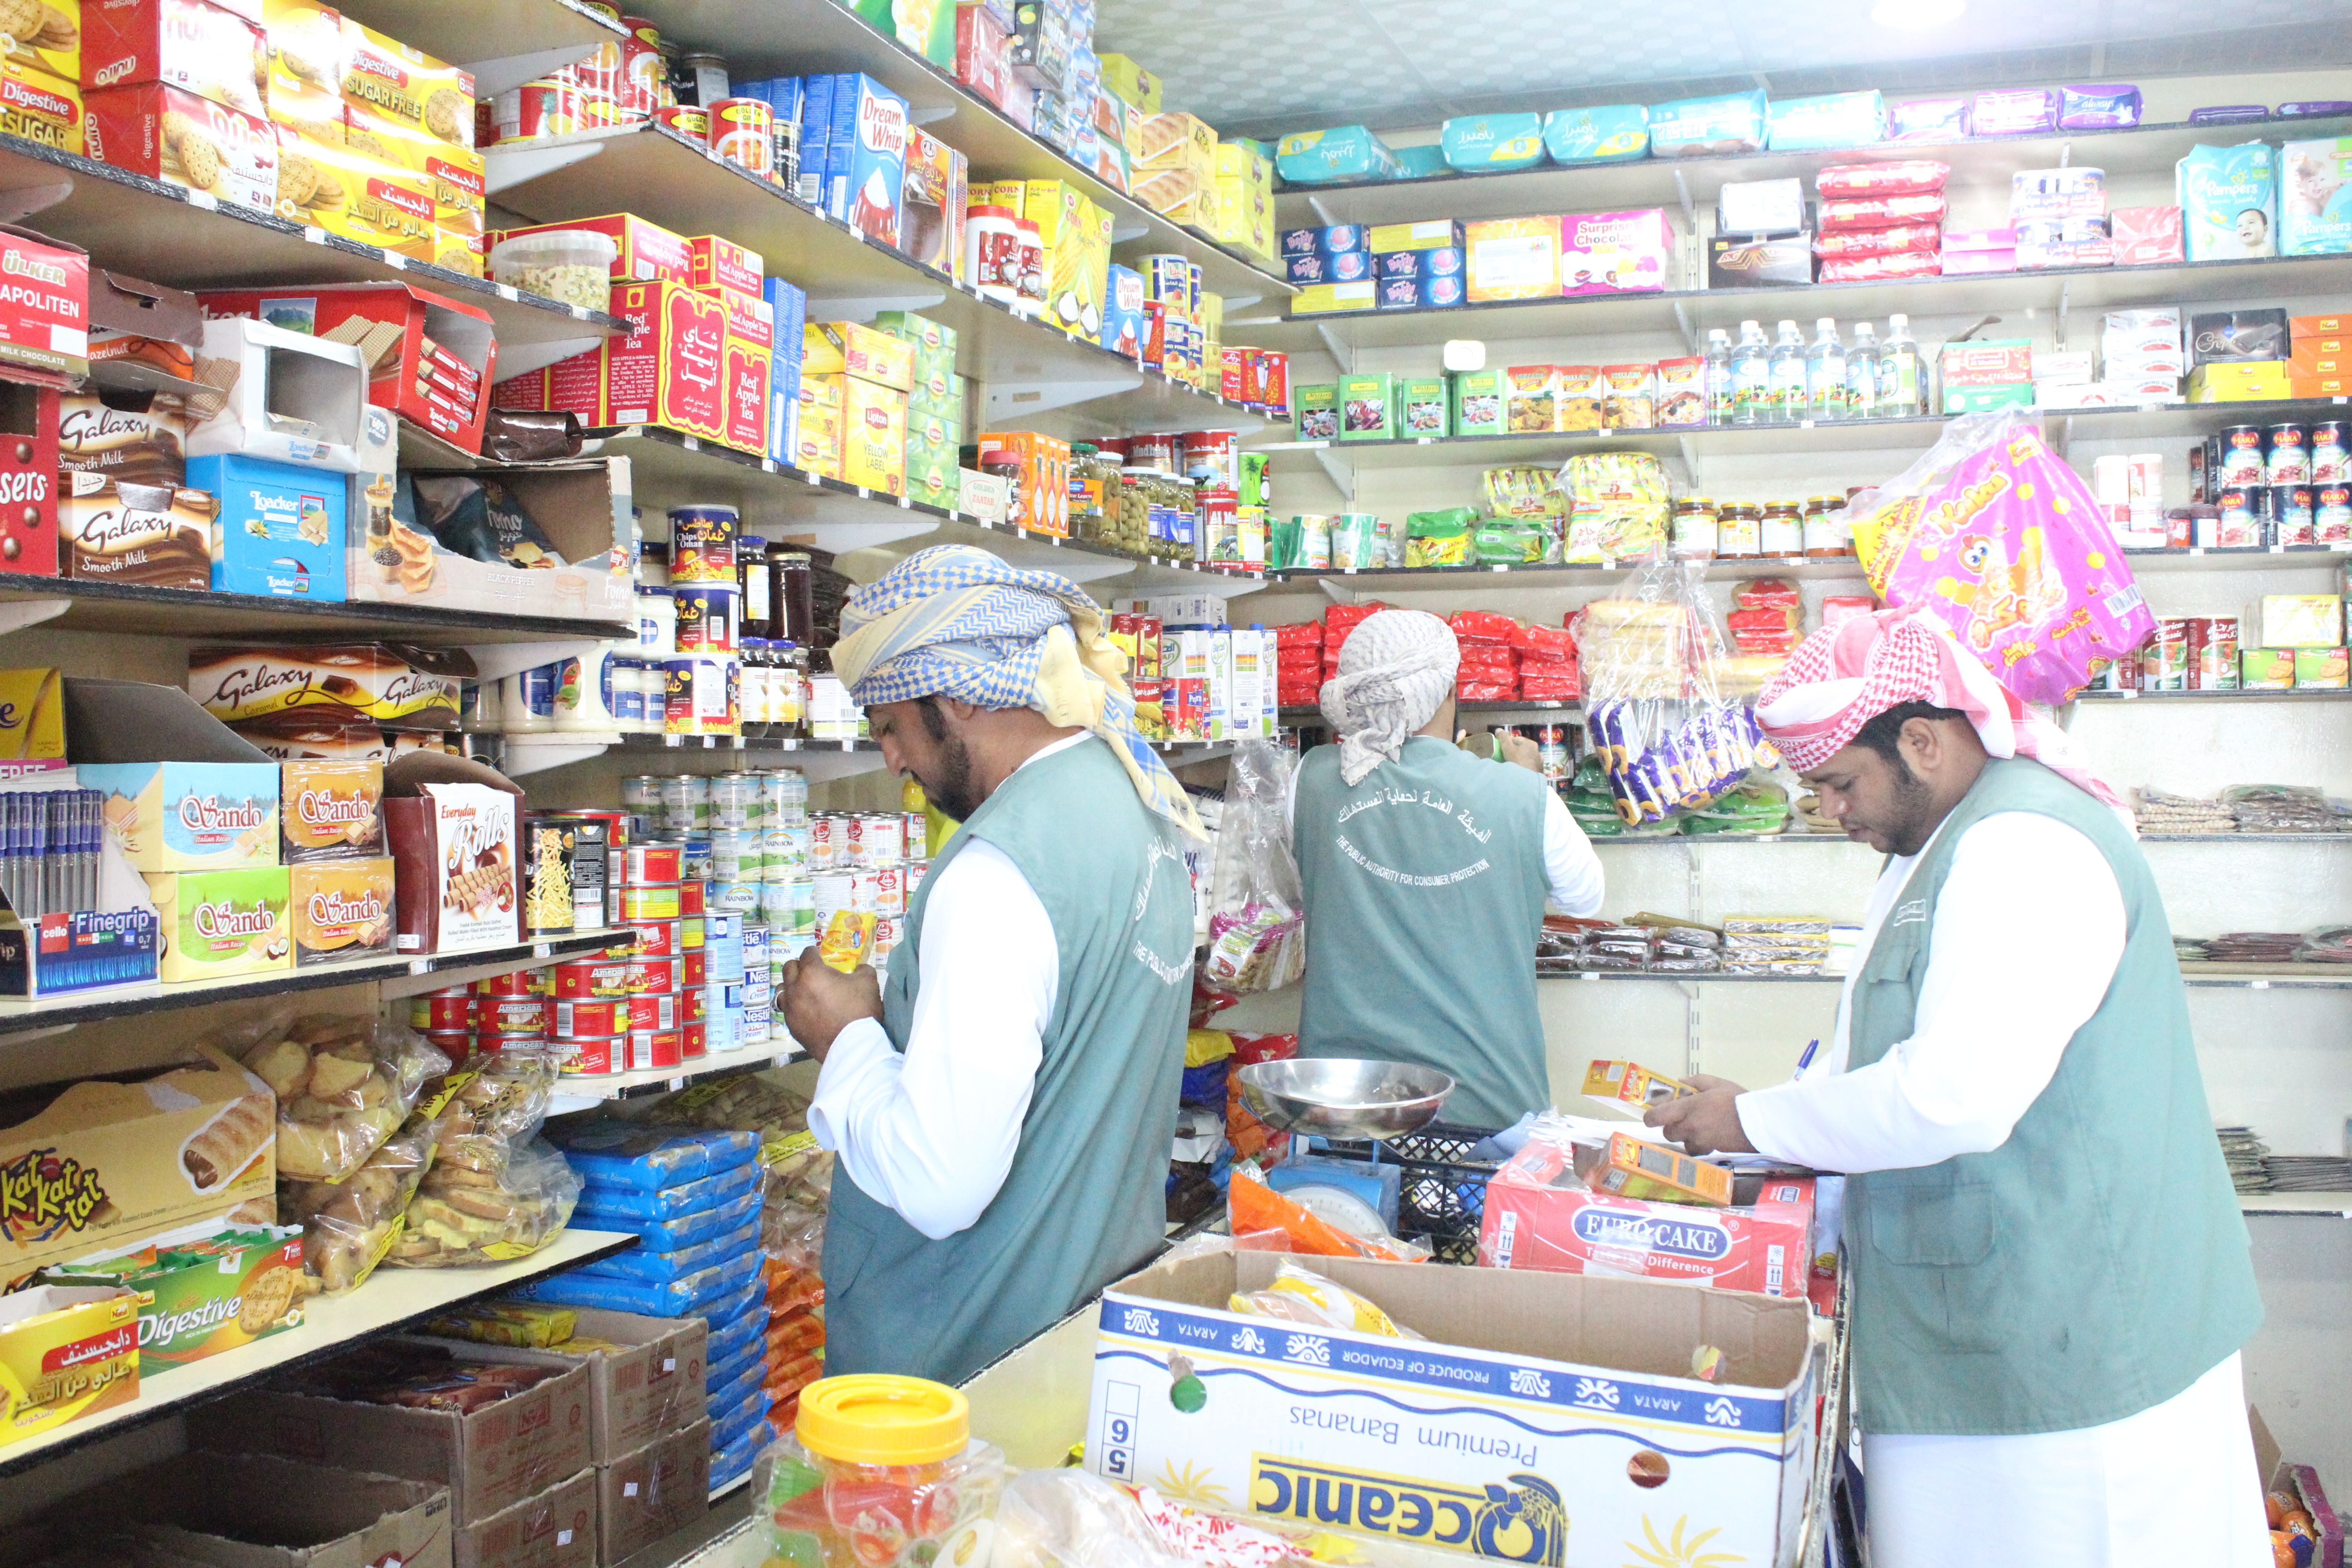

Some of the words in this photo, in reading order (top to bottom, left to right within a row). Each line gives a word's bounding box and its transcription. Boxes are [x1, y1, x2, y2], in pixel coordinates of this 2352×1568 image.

[351, 50, 399, 80] Digestive
[4, 81, 69, 116] Digestive
[347, 74, 391, 109] SUGAR
[391, 93, 421, 119] FREE
[2082, 98, 2115, 110] always
[864, 97, 901, 126] Dream
[5, 113, 68, 151] SUGAR
[142, 113, 152, 159] digestive
[872, 123, 902, 153] Whip
[1621, 136, 1627, 144] 2
[1517, 142, 1523, 150] 2
[2206, 182, 2258, 198] Pampers
[1066, 210, 1083, 229] CORN
[2300, 221, 2351, 235] Pampers
[1593, 245, 1617, 254] EGG
[2, 250, 66, 287] ÜLKER
[718, 261, 730, 273] Red
[730, 267, 746, 283] Apple
[746, 273, 758, 285] Tea
[1118, 279, 1140, 293] Dream
[1123, 293, 1141, 310] Whip
[730, 311, 741, 323] Red
[741, 316, 759, 330] Apple
[758, 323, 769, 334] Tea
[624, 338, 642, 349] Tea
[927, 331, 938, 343] Lipton
[0, 345, 19, 358] MILK
[21, 349, 66, 366] CHOCOLATE
[741, 372, 756, 390] Red
[932, 380, 944, 392] Lipton
[2133, 381, 2160, 390] CHEWING
[2161, 381, 2174, 389] GUM
[736, 388, 760, 406] Apple
[429, 407, 449, 426] Loacker
[740, 403, 754, 421] Tea
[806, 415, 820, 426] LABEL
[867, 409, 887, 425] Lipton
[59, 409, 150, 453] Galaxy
[930, 428, 941, 439] Lipton
[2275, 435, 2298, 443] MARA
[2314, 434, 2333, 442] MARA
[289, 440, 315, 454] Loacker
[803, 444, 817, 454] Lipton
[864, 443, 889, 459] YELLOW
[58, 454, 98, 472] Smooth
[101, 451, 124, 466] Milk
[866, 457, 885, 472] LABEL
[930, 475, 941, 487] Lipton
[973, 483, 995, 494] GOLDEN
[250, 491, 298, 513] Loacker
[972, 494, 995, 506] ZAATAR
[2323, 493, 2345, 501] MARA
[75, 510, 173, 554] Galaxy
[676, 533, 697, 542] Chips
[82, 557, 123, 573] Smooth
[126, 551, 148, 568] Milk
[267, 575, 295, 589] Loacker
[487, 573, 509, 584] BLACK
[510, 575, 535, 587] PEPPER
[2155, 631, 2182, 642] Classic
[2277, 651, 2283, 659] 7
[213, 664, 314, 710] Galaxy
[2244, 679, 2285, 689] Digestive
[2299, 679, 2339, 688] Digestive
[385, 675, 443, 710] Galaxy
[244, 701, 278, 716] Caramel
[1384, 787, 1417, 805] لحماية
[1423, 790, 1453, 814] العامة
[180, 795, 263, 832] Sando
[299, 789, 370, 824] Sando
[441, 804, 476, 821] Everyday
[1338, 791, 1384, 823] المستهلك
[329, 827, 344, 835] Recipe
[1457, 809, 1491, 844] الهيئة
[195, 835, 214, 843] Italian
[216, 834, 233, 843] Recipe
[449, 805, 509, 870] Rolls
[1336, 835, 1348, 850] THE
[1344, 843, 1367, 865] PUBLIC
[1365, 860, 1400, 882] AUTHORITY
[1400, 873, 1413, 885] FOR
[1415, 874, 1450, 887] CONSUMER
[1450, 858, 1490, 884] PROTECTION
[879, 875, 896, 884] Luna
[309, 890, 381, 926] Sando
[77, 909, 149, 935] Finegrip
[195, 900, 275, 938] Sando
[43, 926, 68, 938] cello
[322, 929, 339, 938] Italian
[340, 928, 355, 937] Recipe
[877, 924, 892, 934] Luna
[210, 941, 228, 950] Italian
[229, 940, 247, 950] Recipe
[1133, 939, 1147, 962] THE
[591, 967, 626, 978] American
[750, 990, 767, 1000] Cream
[497, 1003, 542, 1013] American
[501, 1041, 544, 1049] American
[1653, 1225, 1718, 1254] CAKE
[284, 1245, 291, 1261] 7
[1648, 1256, 1714, 1275] Difference
[138, 1296, 242, 1346] Digestive
[1179, 1323, 1218, 1340] ARATA
[61, 1328, 131, 1366] دايجيستف
[1343, 1350, 1404, 1371] ECUADOR
[1408, 1361, 1425, 1373] OF
[1429, 1363, 1490, 1383] PRODUCE
[1633, 1394, 1681, 1412] ARATA
[1290, 1406, 1400, 1445] Bananas
[1418, 1426, 1539, 1469] Premium
